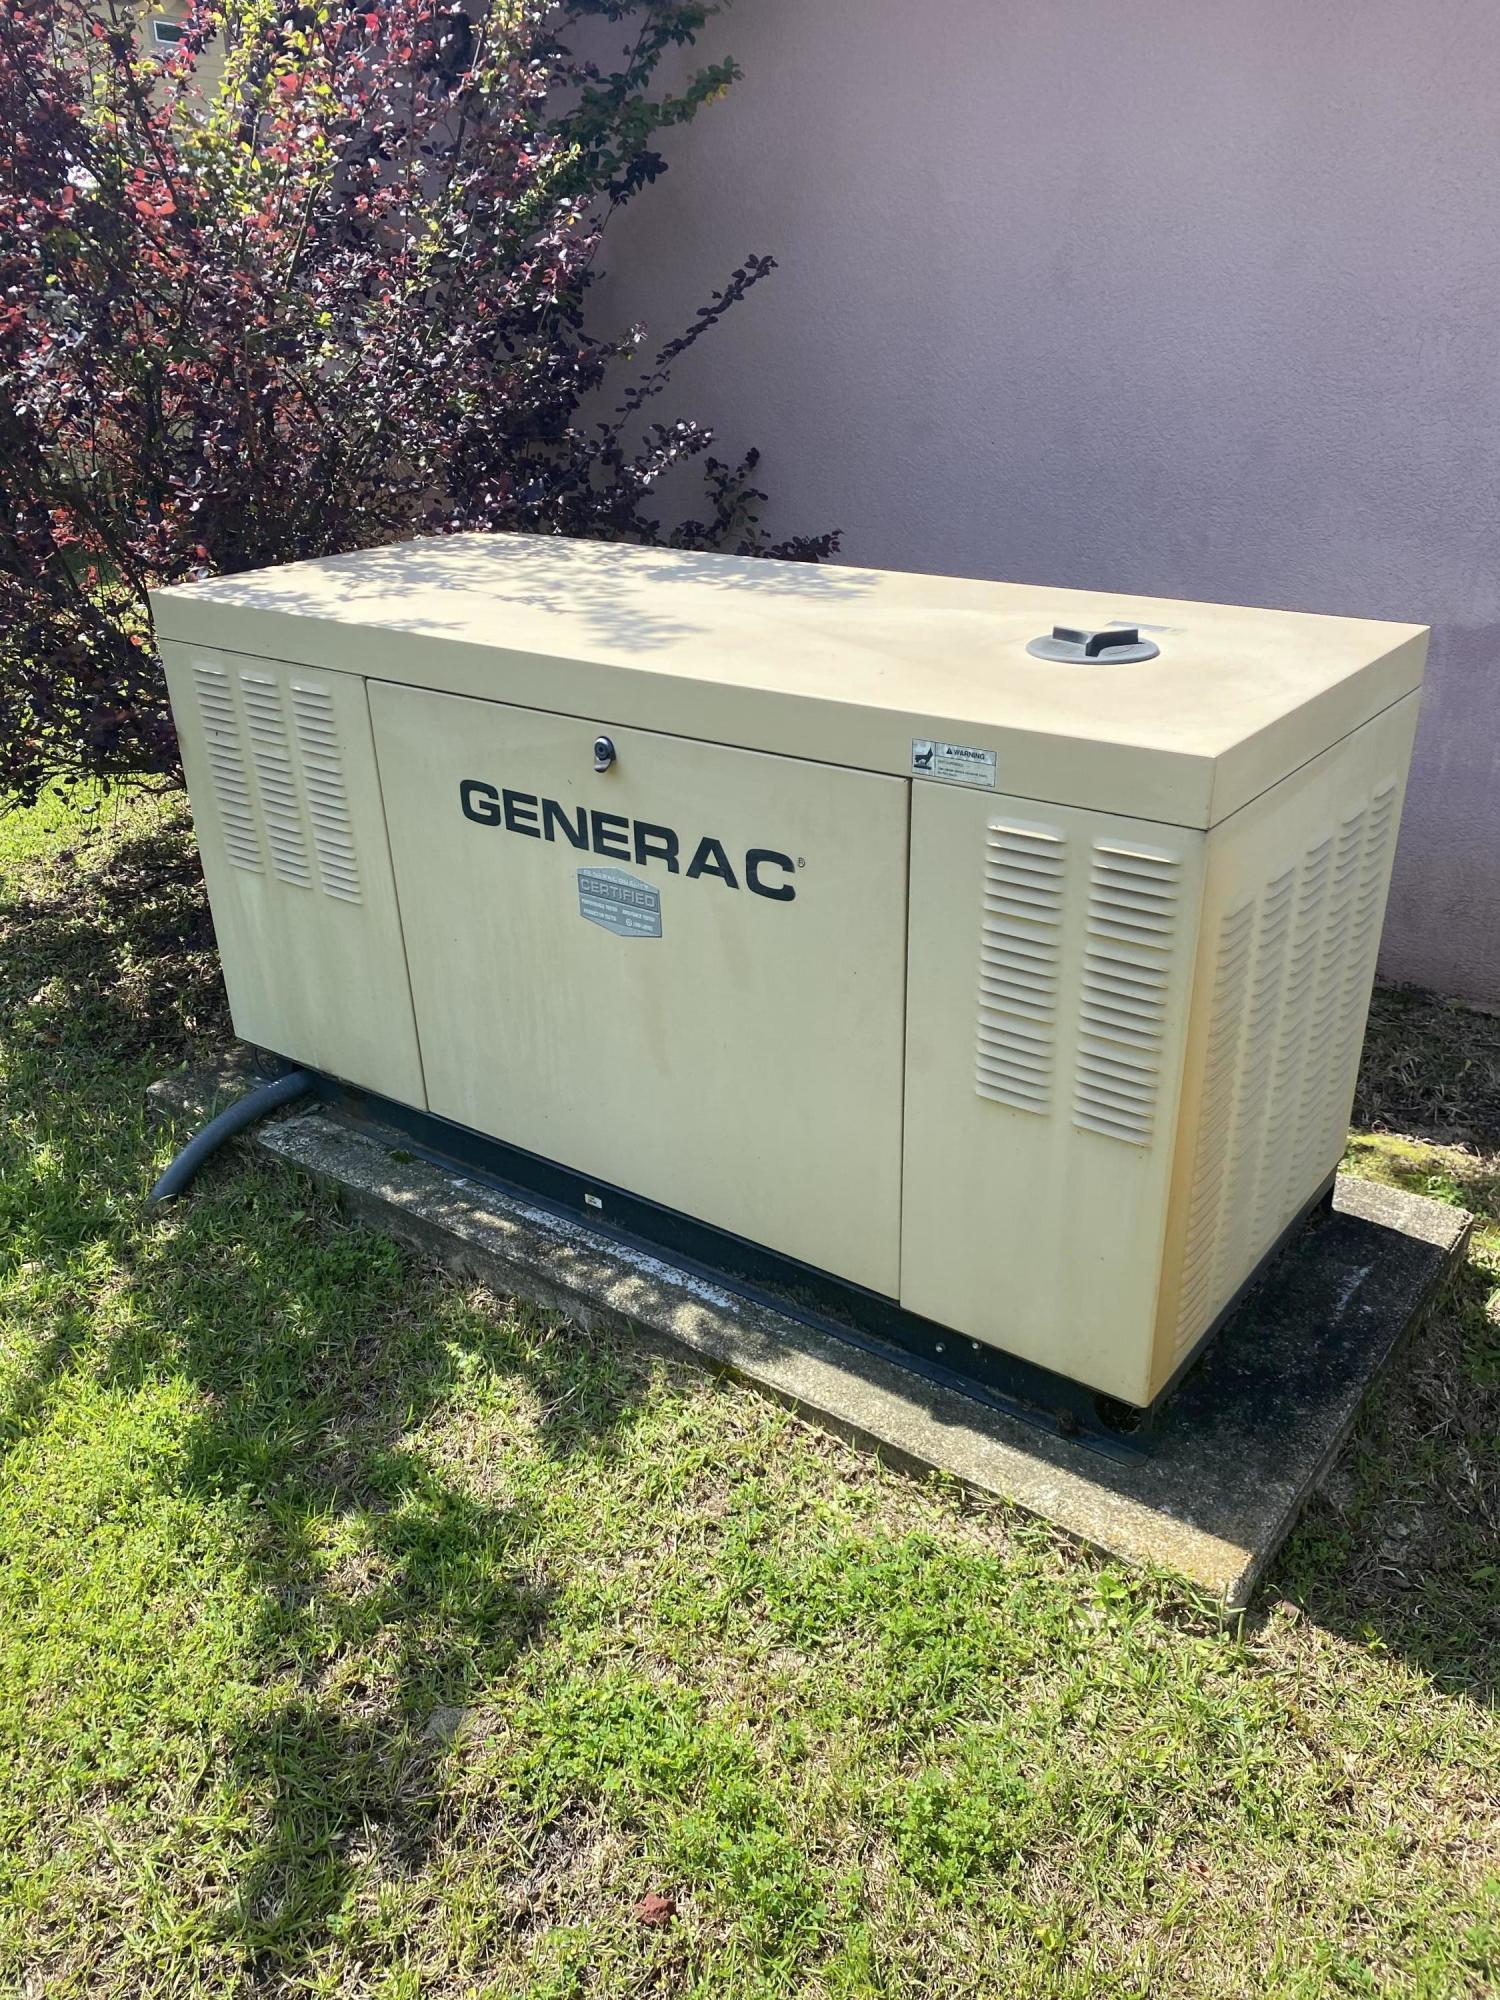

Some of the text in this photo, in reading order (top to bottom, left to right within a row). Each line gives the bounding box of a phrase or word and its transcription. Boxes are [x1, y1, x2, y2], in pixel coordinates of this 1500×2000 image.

[953, 749, 985, 760] WARNING
[459, 779, 796, 902] GENERAC
[580, 878, 656, 908] CERTIFIED
